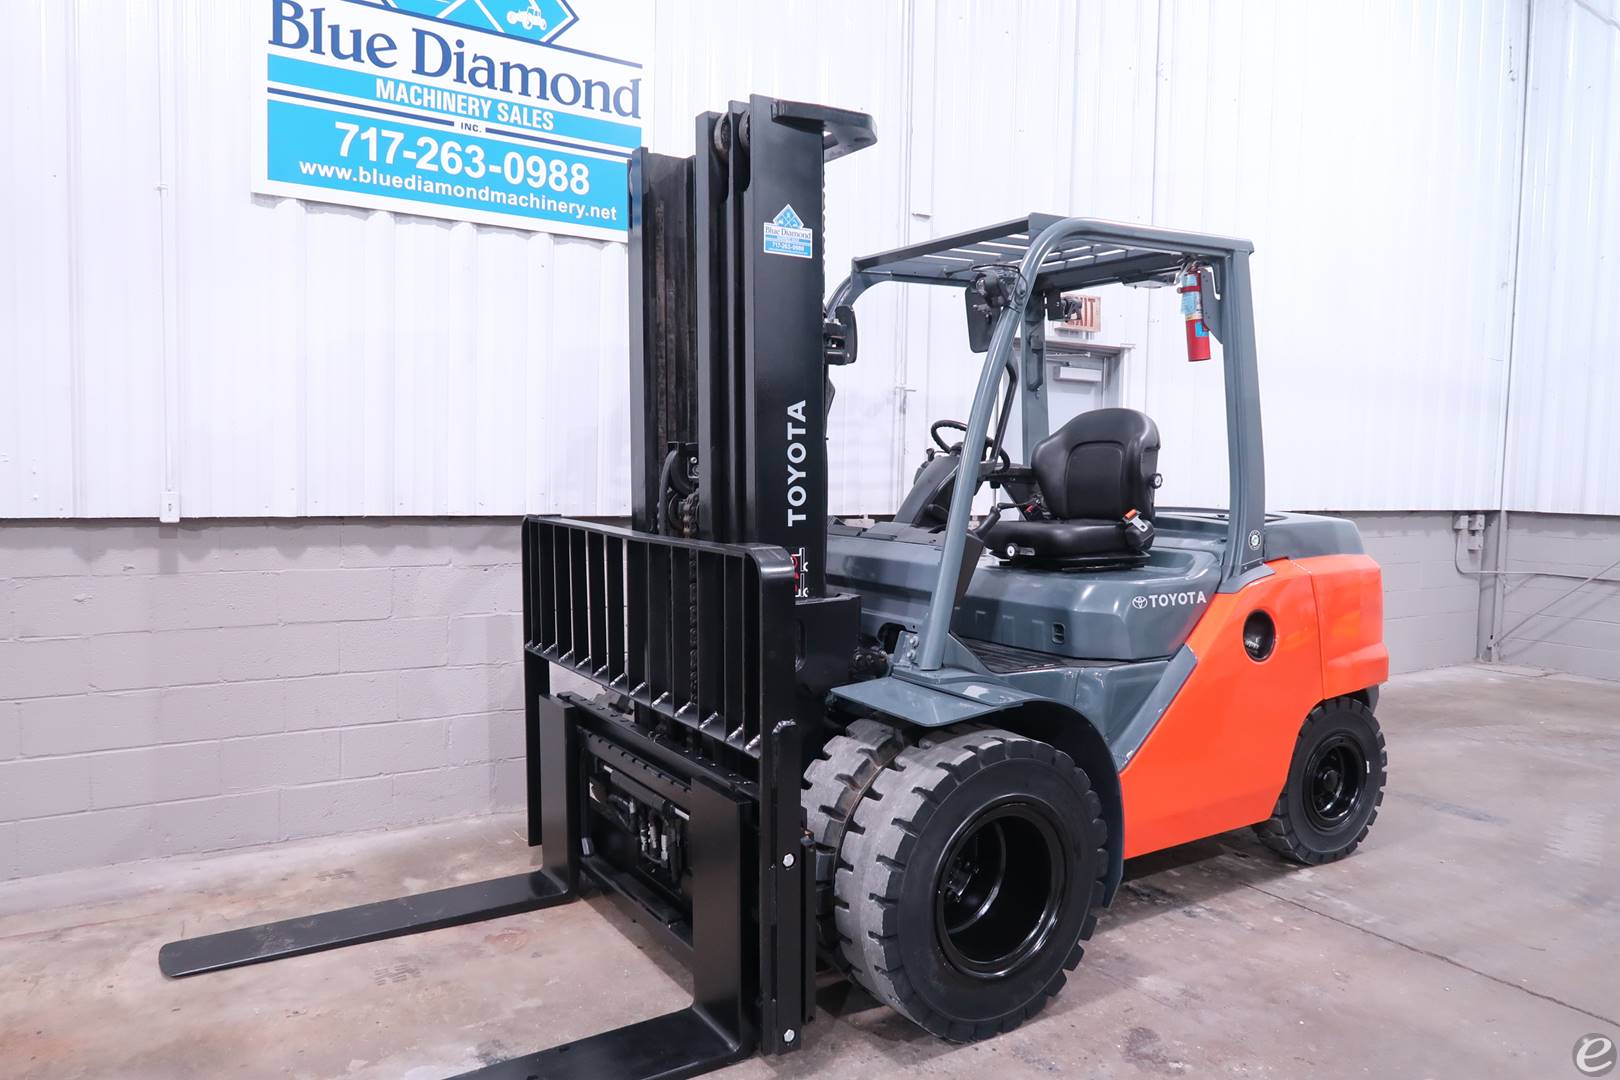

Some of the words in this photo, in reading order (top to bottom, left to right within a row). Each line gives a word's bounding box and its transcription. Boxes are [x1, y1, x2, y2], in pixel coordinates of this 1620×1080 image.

[268, 0, 398, 69] Blue
[411, 27, 642, 119] Diamond
[375, 78, 491, 119] MACHINERY
[497, 103, 555, 130] SALES
[460, 122, 483, 134] INC.
[334, 121, 590, 195] 717-263-0988
[299, 160, 617, 221] www.bluediamondmachinery.net
[787, 400, 807, 527] TOYOTA
[1148, 590, 1207, 608] TOYOTA
